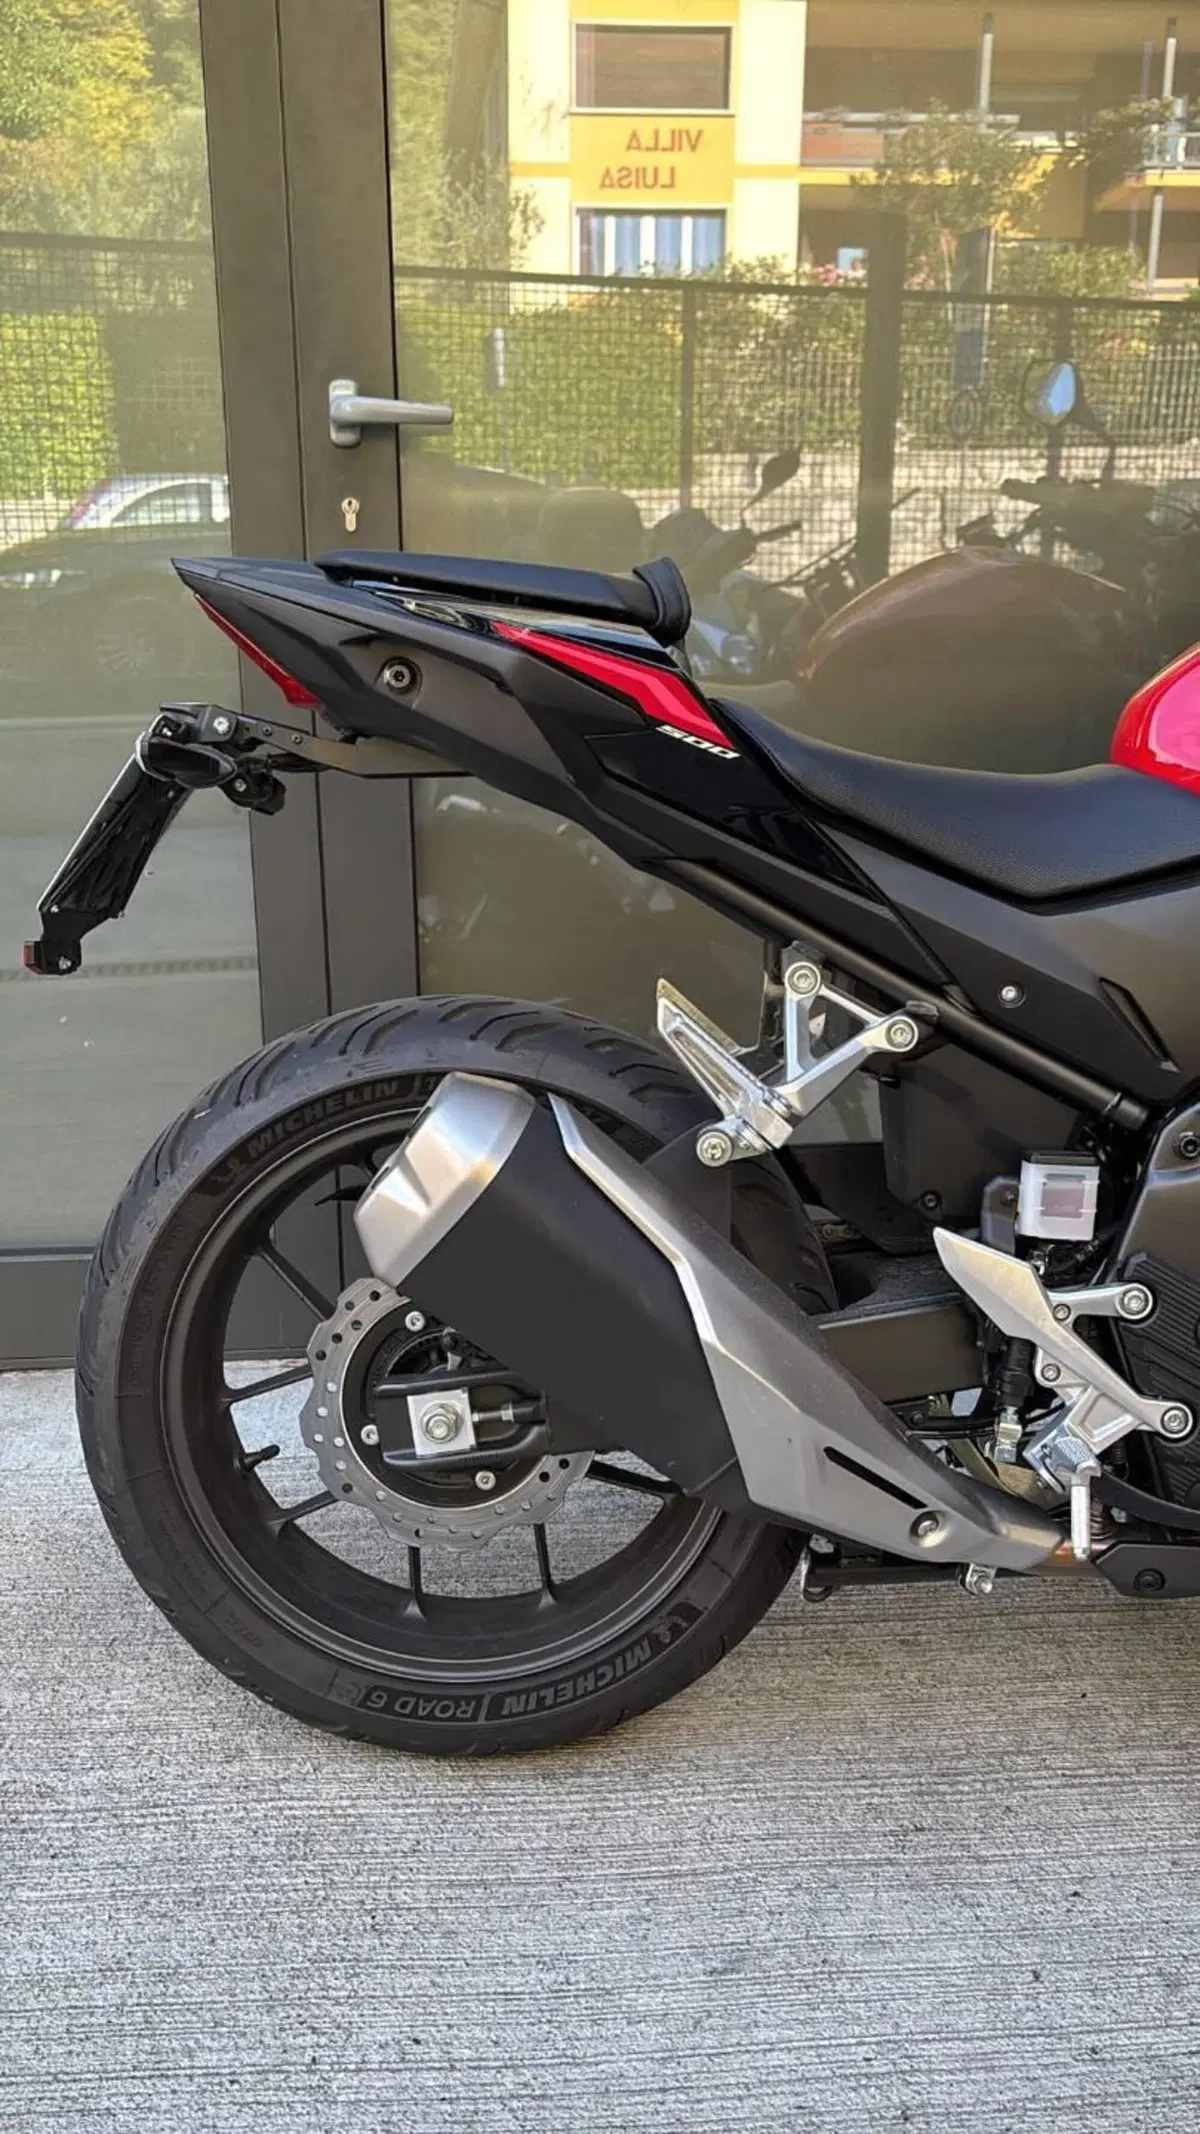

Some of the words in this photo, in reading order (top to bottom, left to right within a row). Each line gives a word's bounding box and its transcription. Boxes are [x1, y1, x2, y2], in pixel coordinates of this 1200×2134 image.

[655, 724, 742, 760] 500
[247, 1079, 399, 1159] MICHELIN
[500, 1637, 652, 1717] MICHELIN
[365, 1691, 389, 1709] 6
[393, 1696, 477, 1719] ROAD
